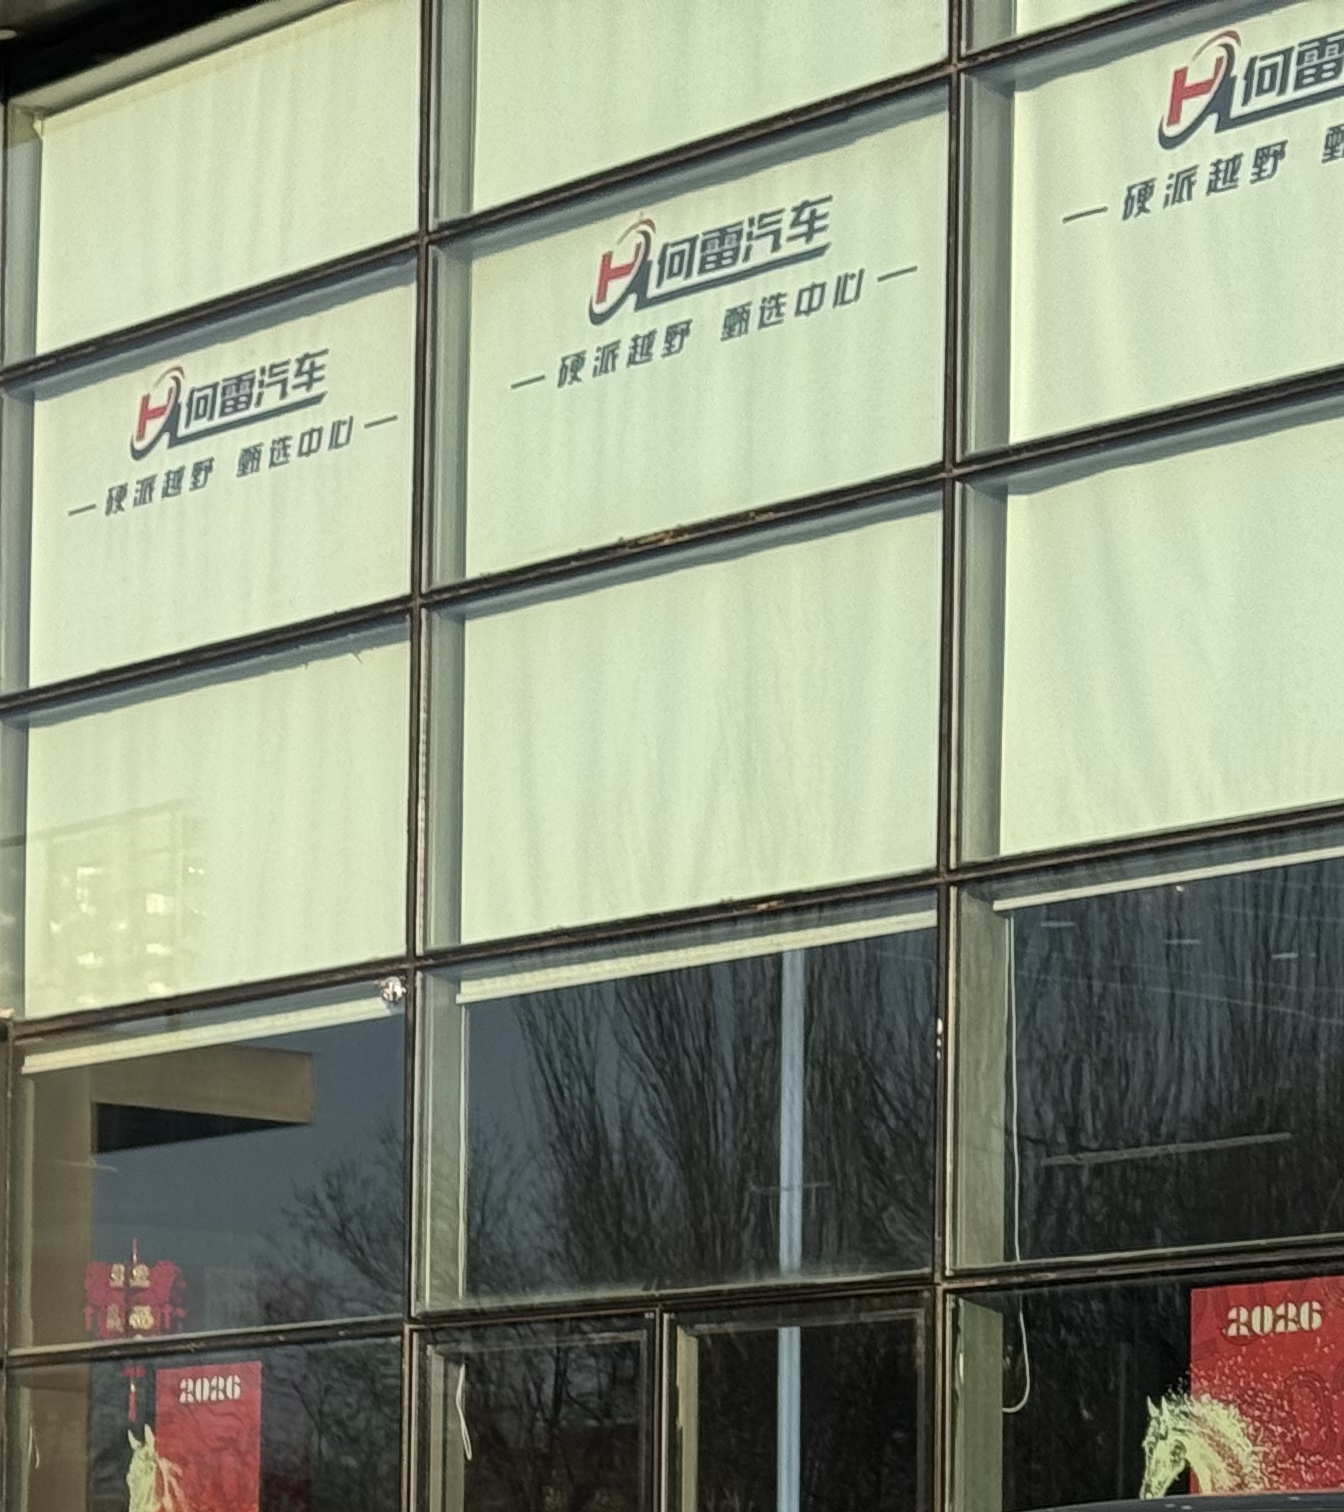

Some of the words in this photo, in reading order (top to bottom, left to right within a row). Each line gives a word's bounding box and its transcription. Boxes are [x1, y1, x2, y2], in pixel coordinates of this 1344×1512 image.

[1122, 139, 1289, 221] 硬派越野
[655, 194, 833, 288] 何雷汽车
[557, 319, 693, 389] 硬派越野
[721, 268, 865, 342] 甄选中心
[184, 348, 330, 429] 何雷汽车
[1227, 1301, 1322, 1336] 2026
[179, 1375, 241, 1404] 2026
